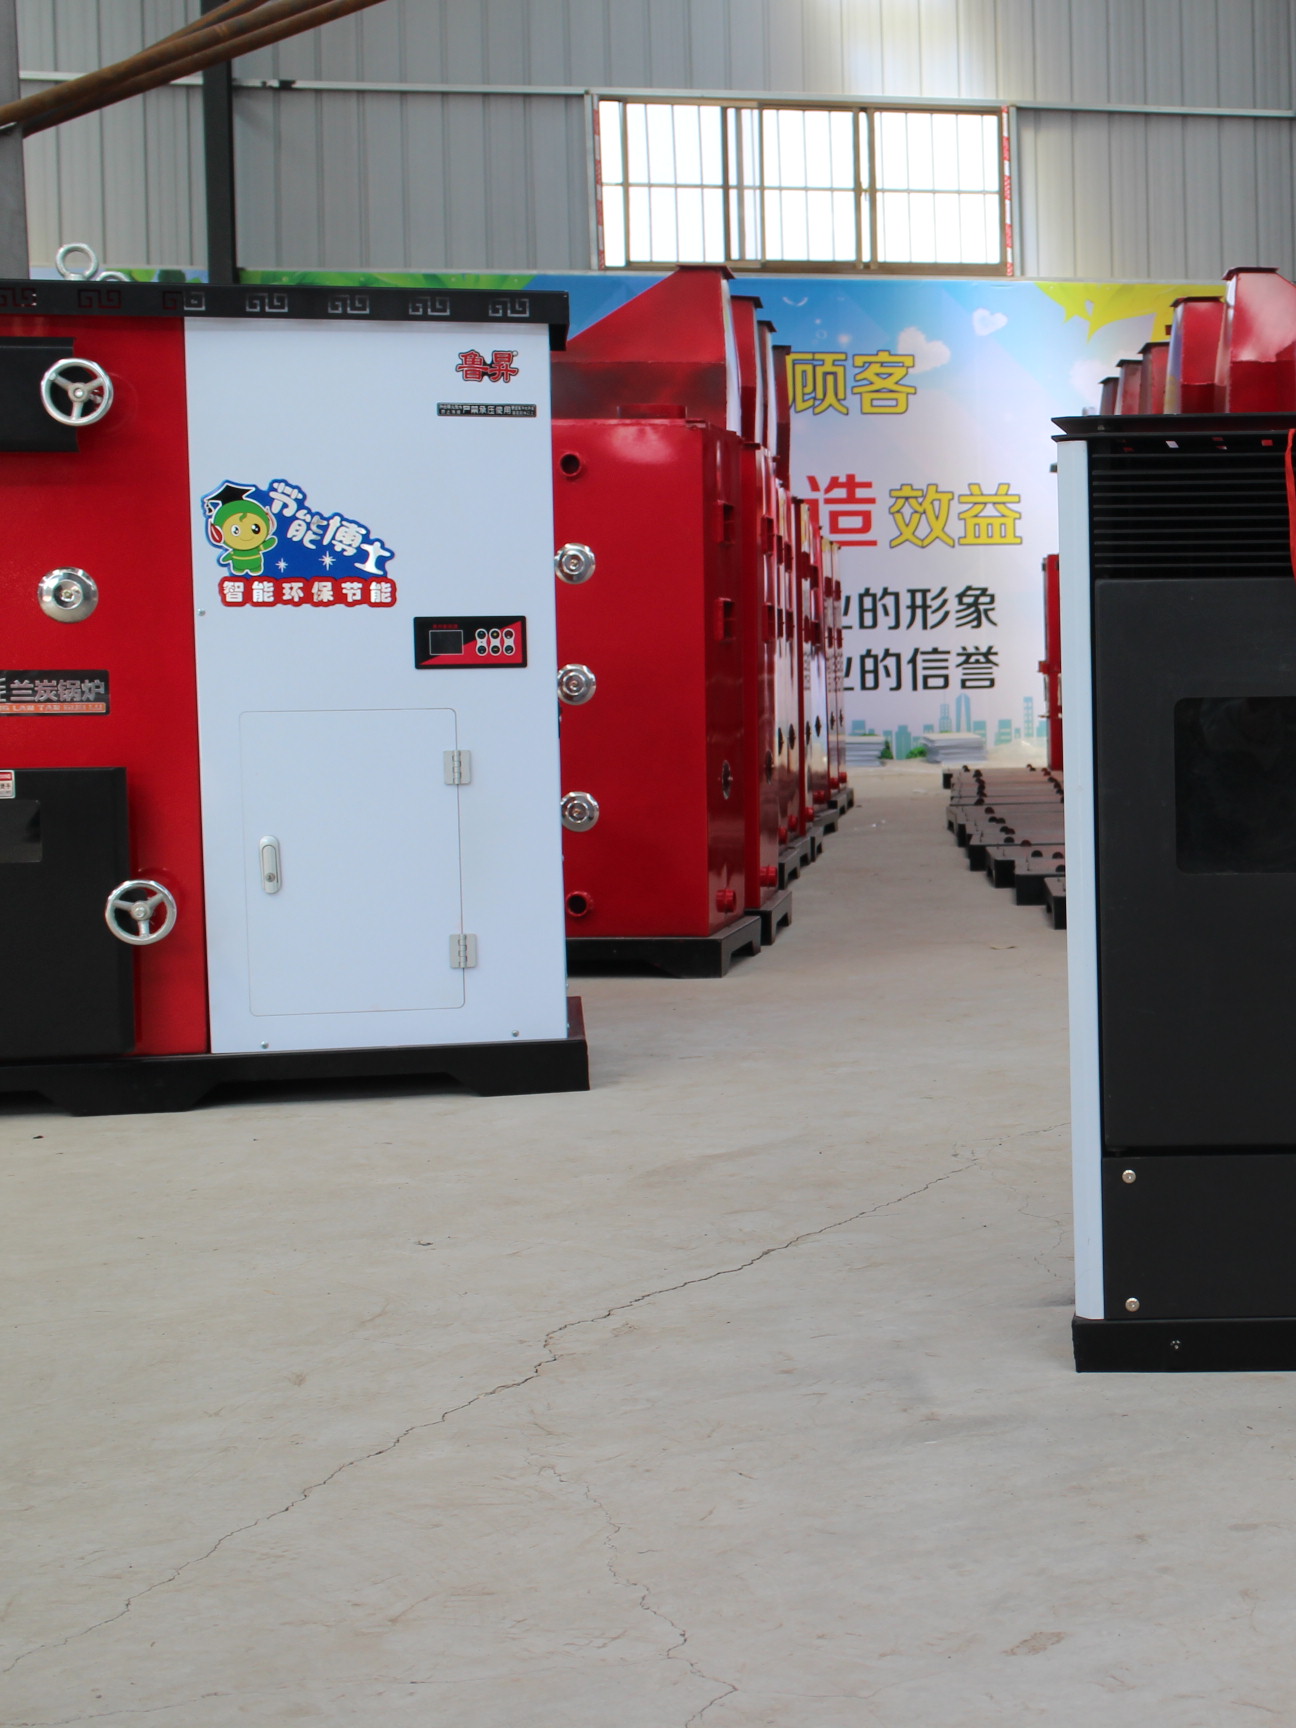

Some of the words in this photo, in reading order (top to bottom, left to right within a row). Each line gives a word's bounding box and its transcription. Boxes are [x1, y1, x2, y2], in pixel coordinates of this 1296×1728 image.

[456, 350, 519, 383] 鲁昇
[785, 350, 917, 415] 顾客
[268, 481, 391, 576] 节能博士
[222, 580, 393, 603] 智能环保节能
